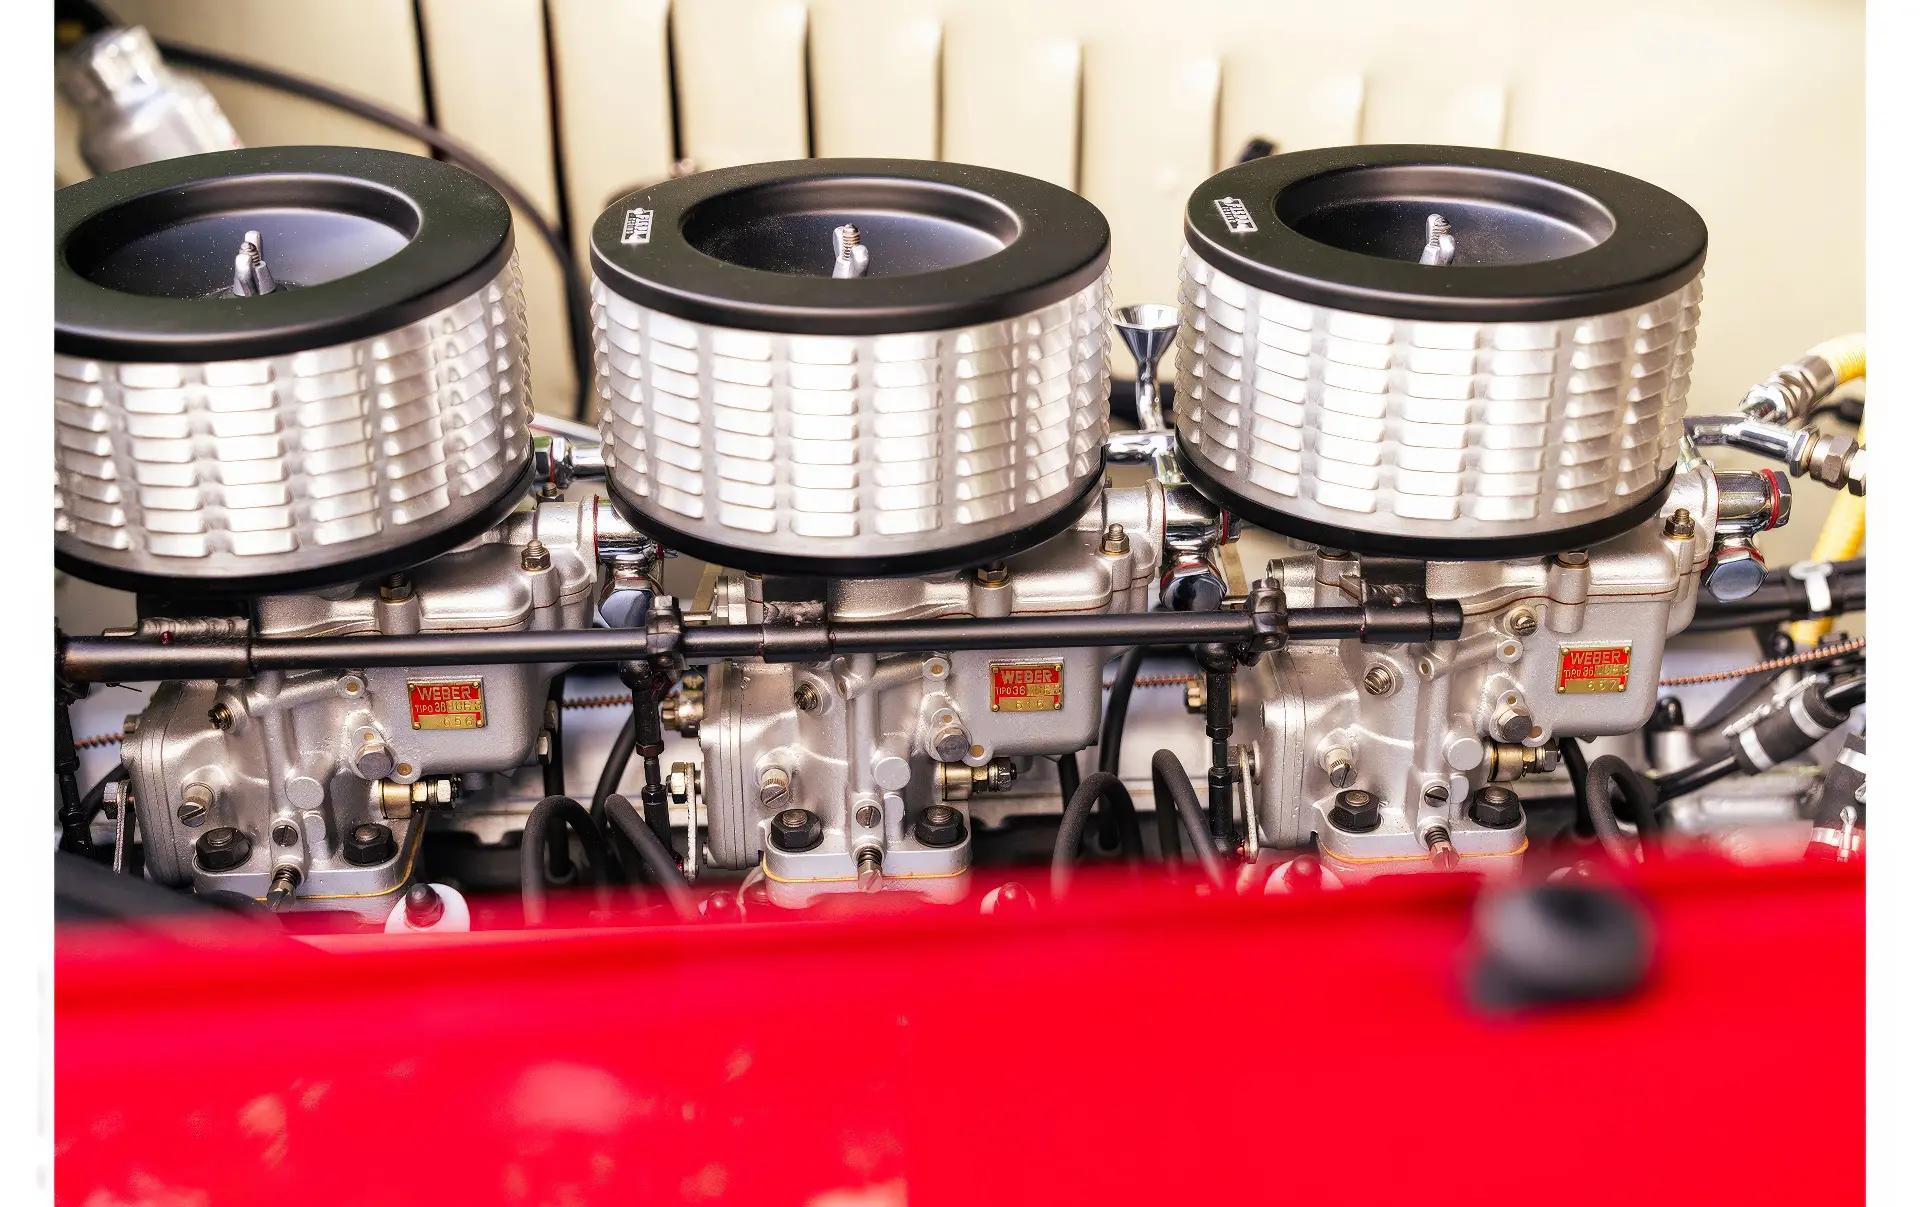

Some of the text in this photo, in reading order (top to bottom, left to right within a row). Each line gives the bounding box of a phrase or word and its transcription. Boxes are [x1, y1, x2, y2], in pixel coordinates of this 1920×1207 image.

[1570, 651, 1621, 665] WEBER
[1000, 669, 1053, 685] WEBER
[416, 685, 472, 701] WEBER
[995, 686, 1012, 695] TIPO
[414, 704, 434, 713] TIPO
